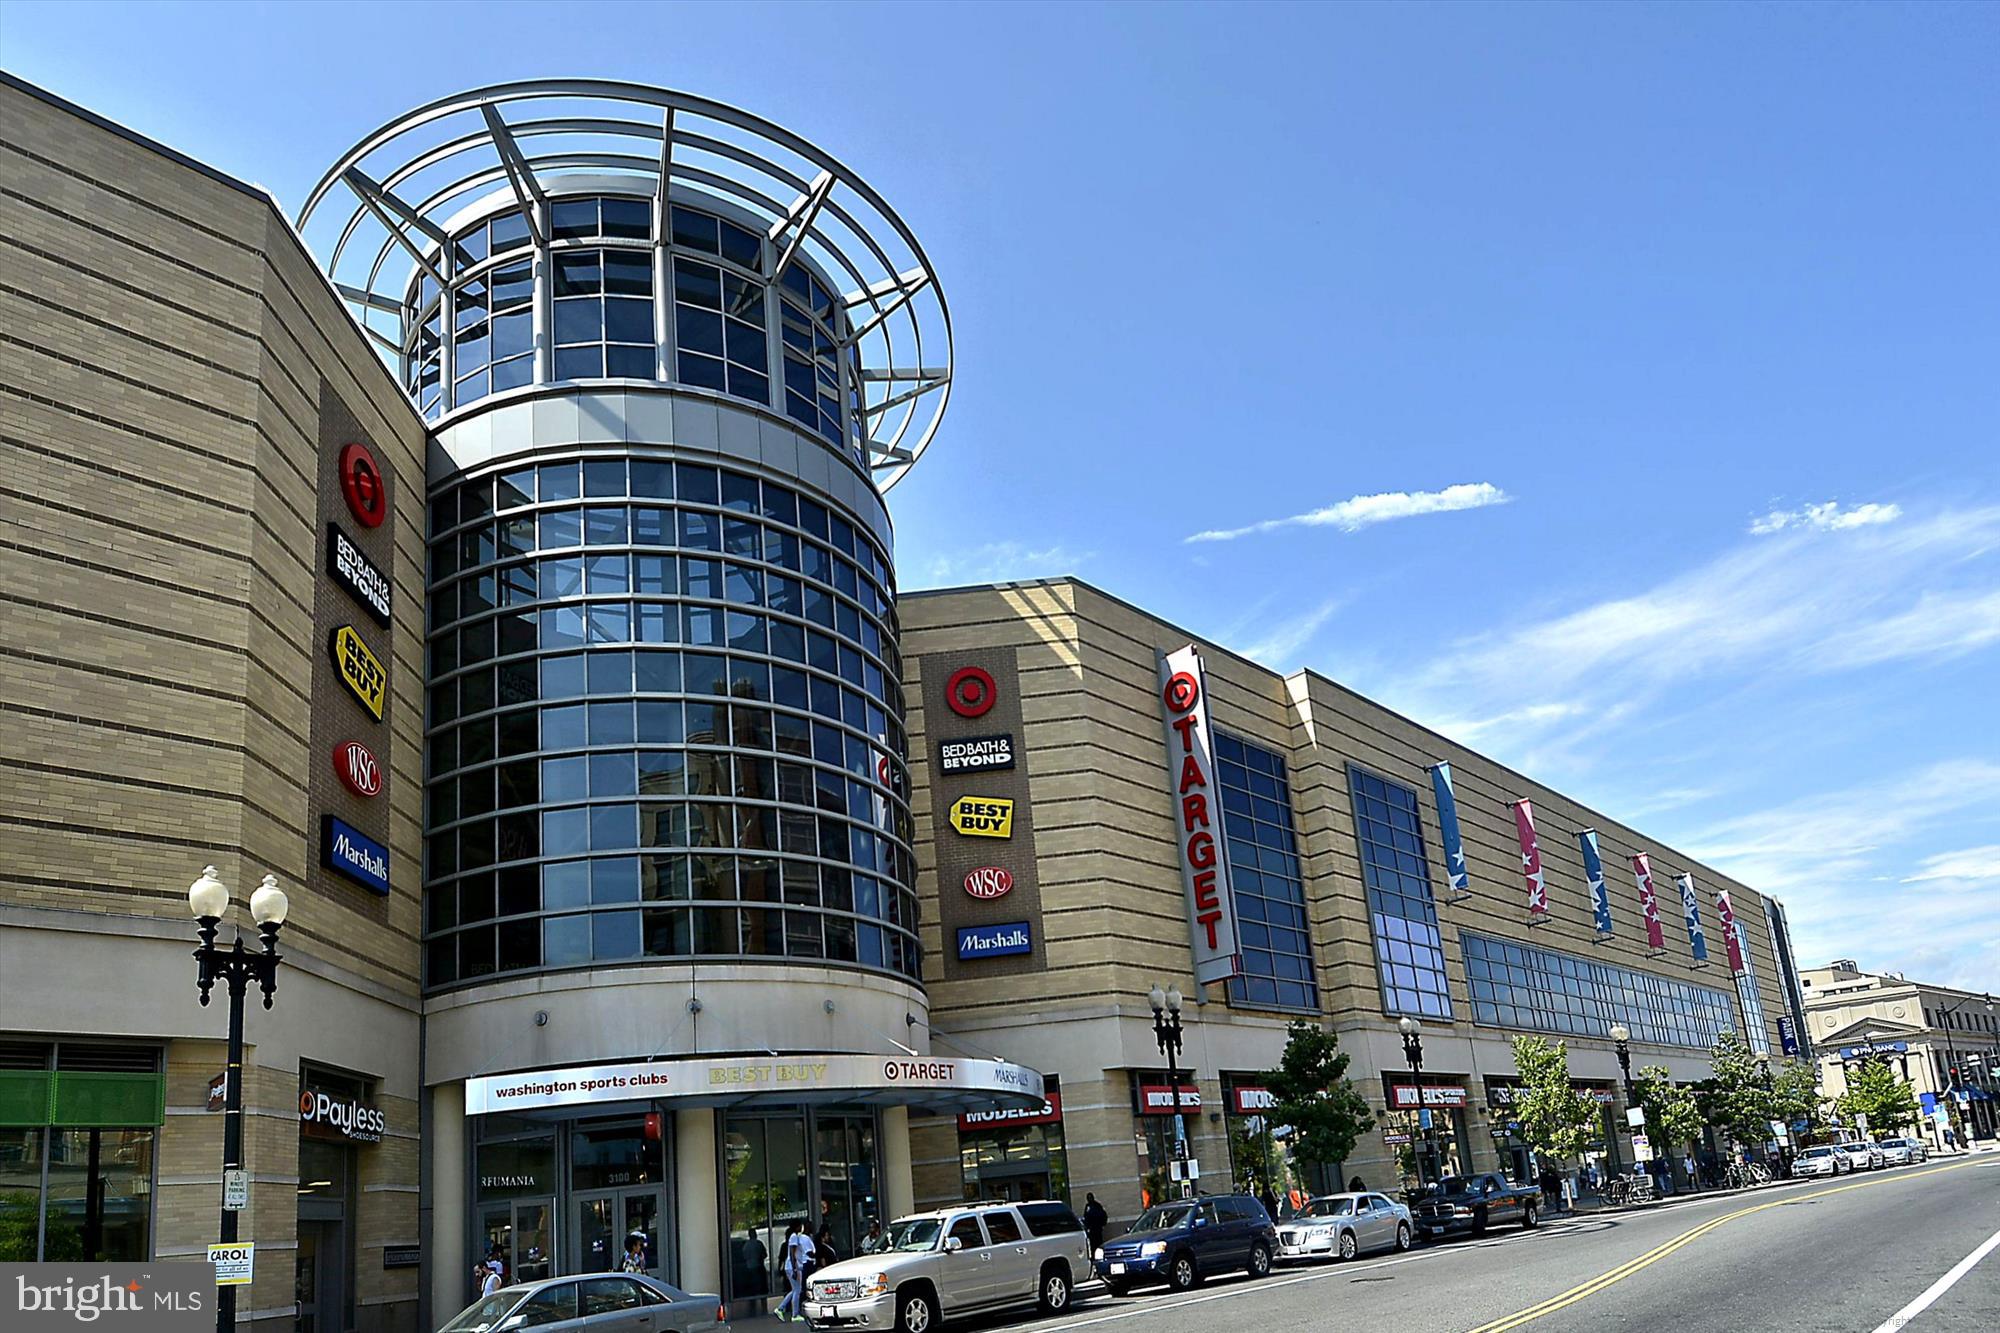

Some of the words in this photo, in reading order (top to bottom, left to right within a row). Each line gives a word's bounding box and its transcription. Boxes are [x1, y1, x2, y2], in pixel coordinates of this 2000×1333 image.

[337, 553, 390, 617] BEYOND
[344, 630, 385, 687] BEST
[343, 653, 380, 704] BUY
[347, 745, 377, 792] WSC
[942, 752, 1012, 769] BEYOND
[959, 802, 1011, 817] BEST
[960, 817, 1005, 831] BUY
[1172, 714, 1223, 950] TARGET
[333, 833, 388, 882] Marshalls
[968, 869, 1007, 896] WSC
[960, 930, 1029, 951] Marshalls
[1781, 1017, 1795, 1040] PARK
[708, 1065, 772, 1085] BEST
[776, 1063, 827, 1082] BUY
[899, 1063, 955, 1080] TARGET
[495, 1081, 577, 1099] washington
[579, 1075, 626, 1092] sports
[629, 1072, 668, 1086] clubs
[316, 1092, 385, 1135] Payless
[349, 1130, 381, 1143] SHOESOURCE
[608, 1172, 630, 1184] 3100
[210, 1249, 249, 1262] CAROL
